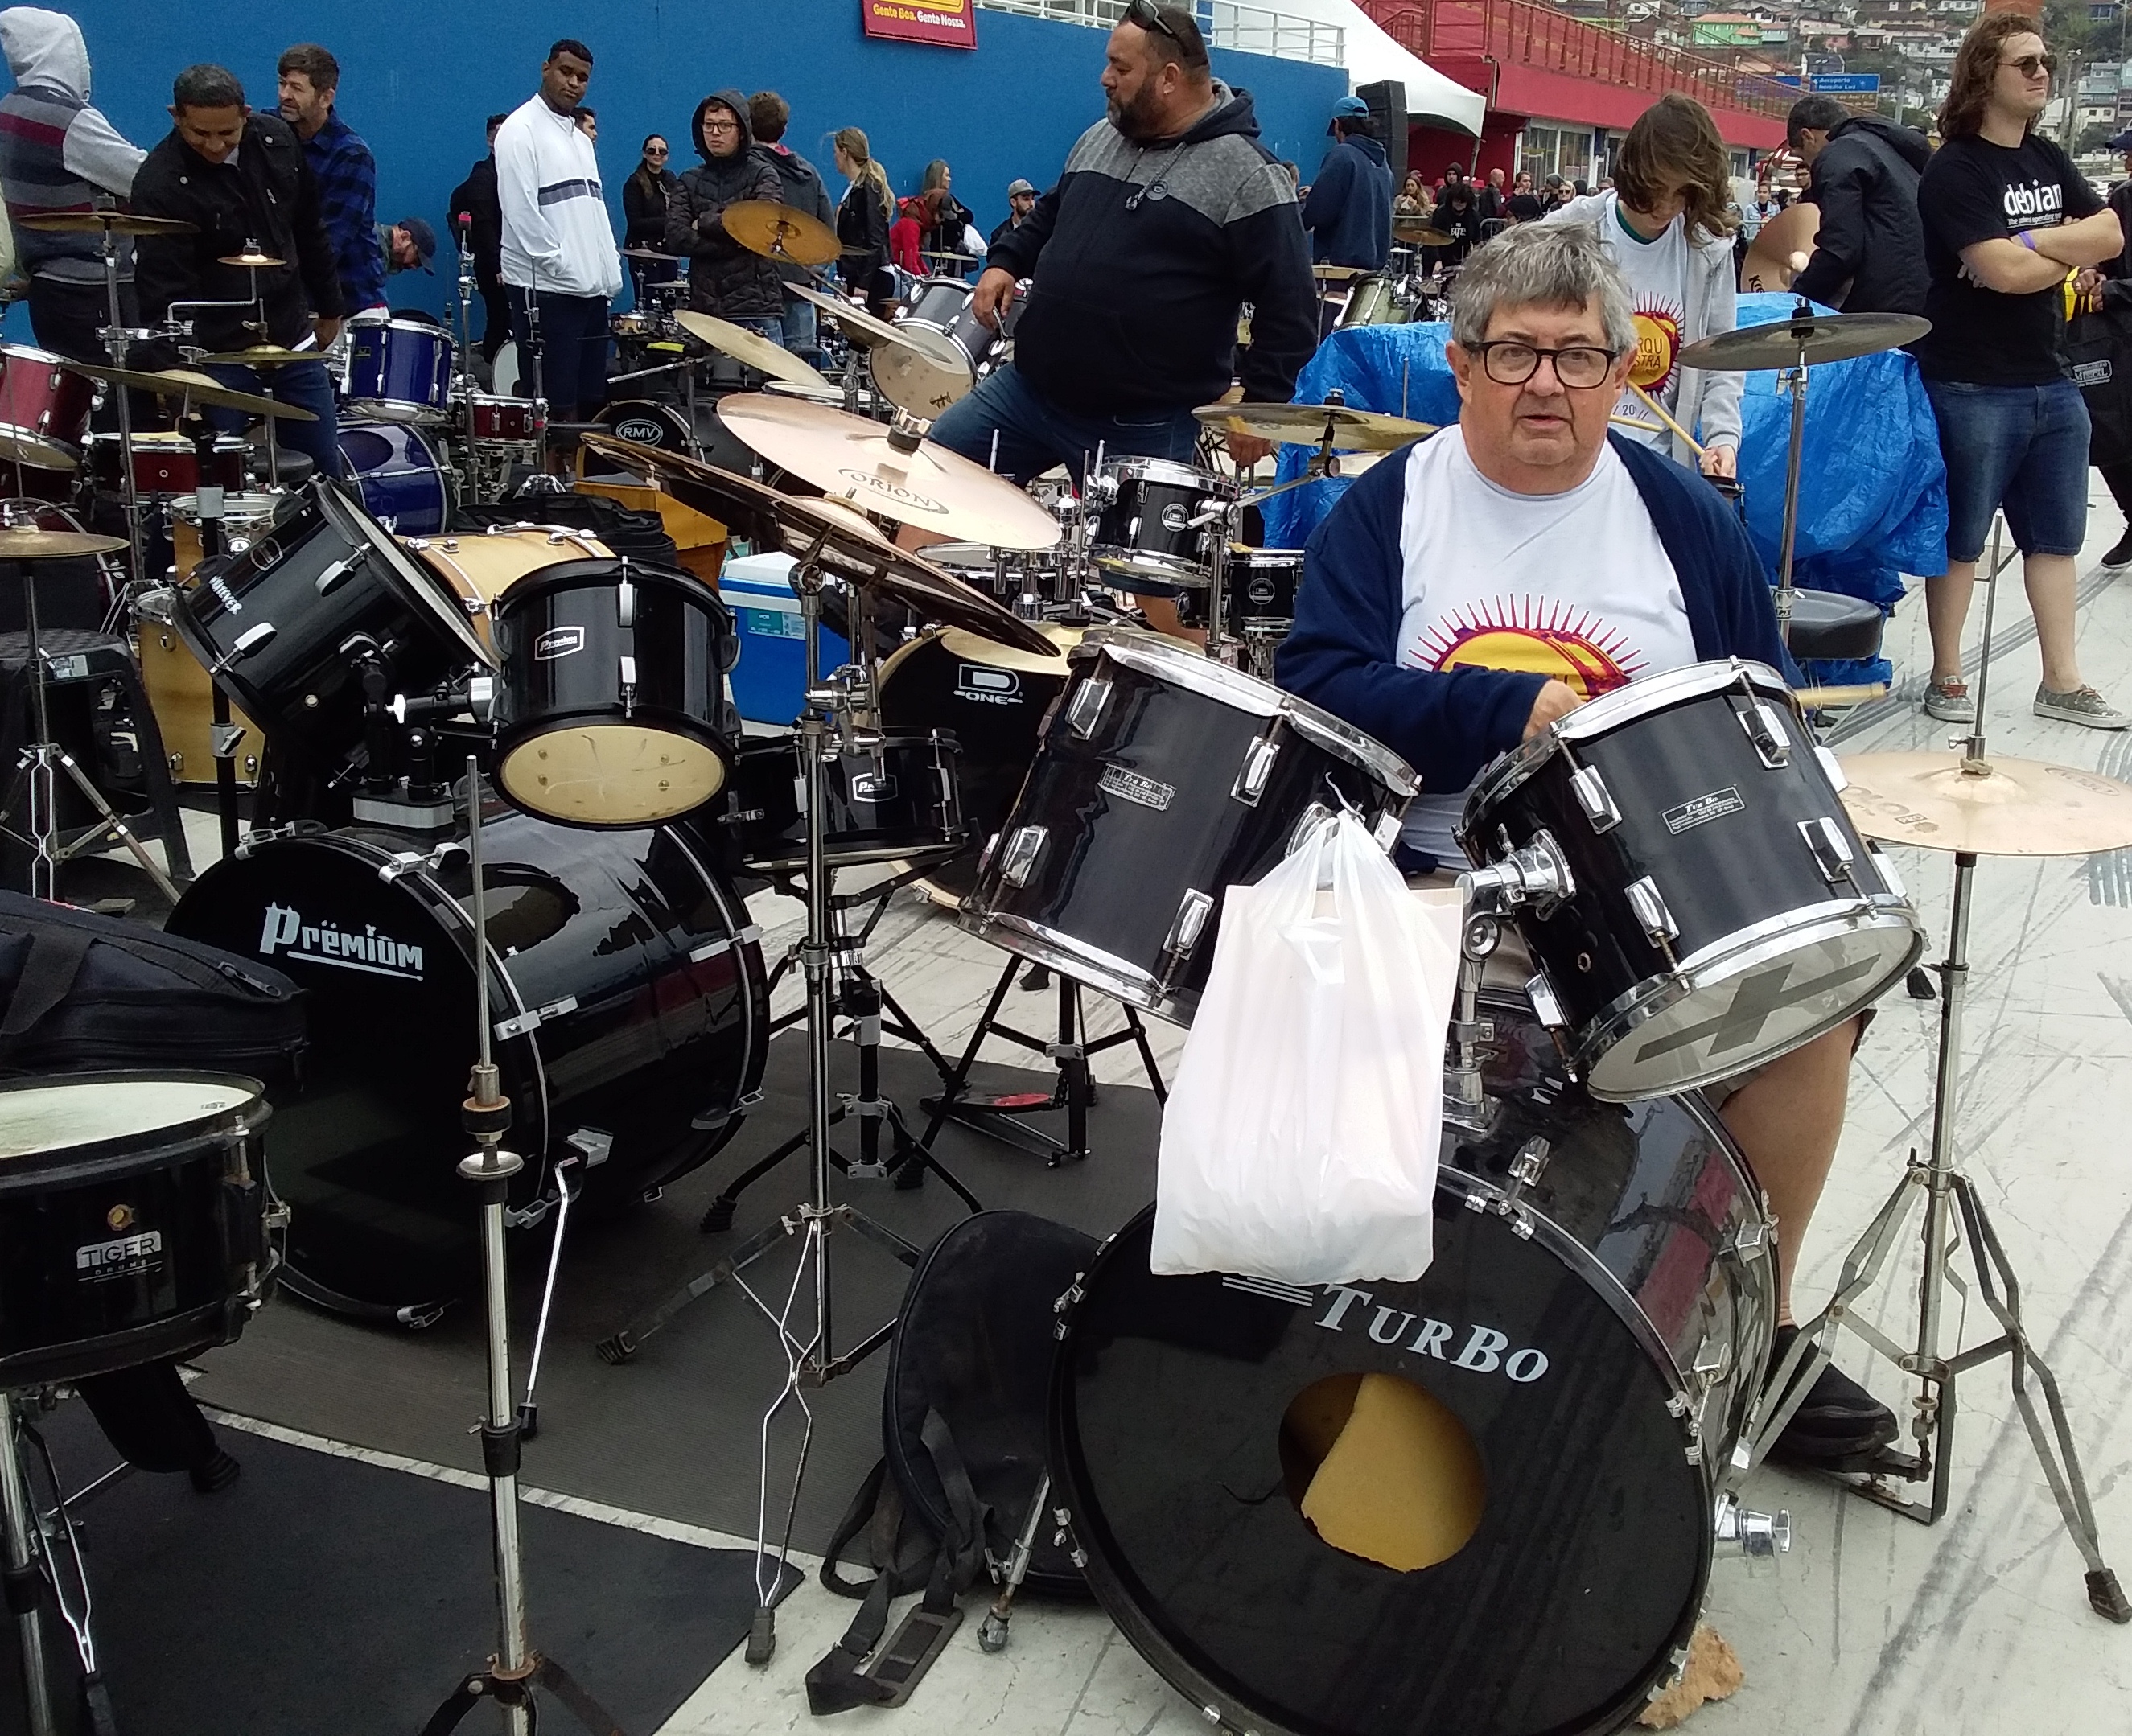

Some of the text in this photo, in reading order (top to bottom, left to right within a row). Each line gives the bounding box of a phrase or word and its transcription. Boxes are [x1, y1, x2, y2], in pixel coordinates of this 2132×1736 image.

[873, 3, 966, 28] Gente Boa. Gente Nossa.
[2004, 179, 2063, 216] debian
[1637, 337, 1663, 354] RQU
[1635, 354, 1661, 368] STRA
[1622, 404, 1637, 416] 20
[624, 426, 656, 438] RMV
[850, 473, 930, 507] ORION
[965, 691, 1009, 706] ONE
[81, 1237, 155, 1267] TIGER
